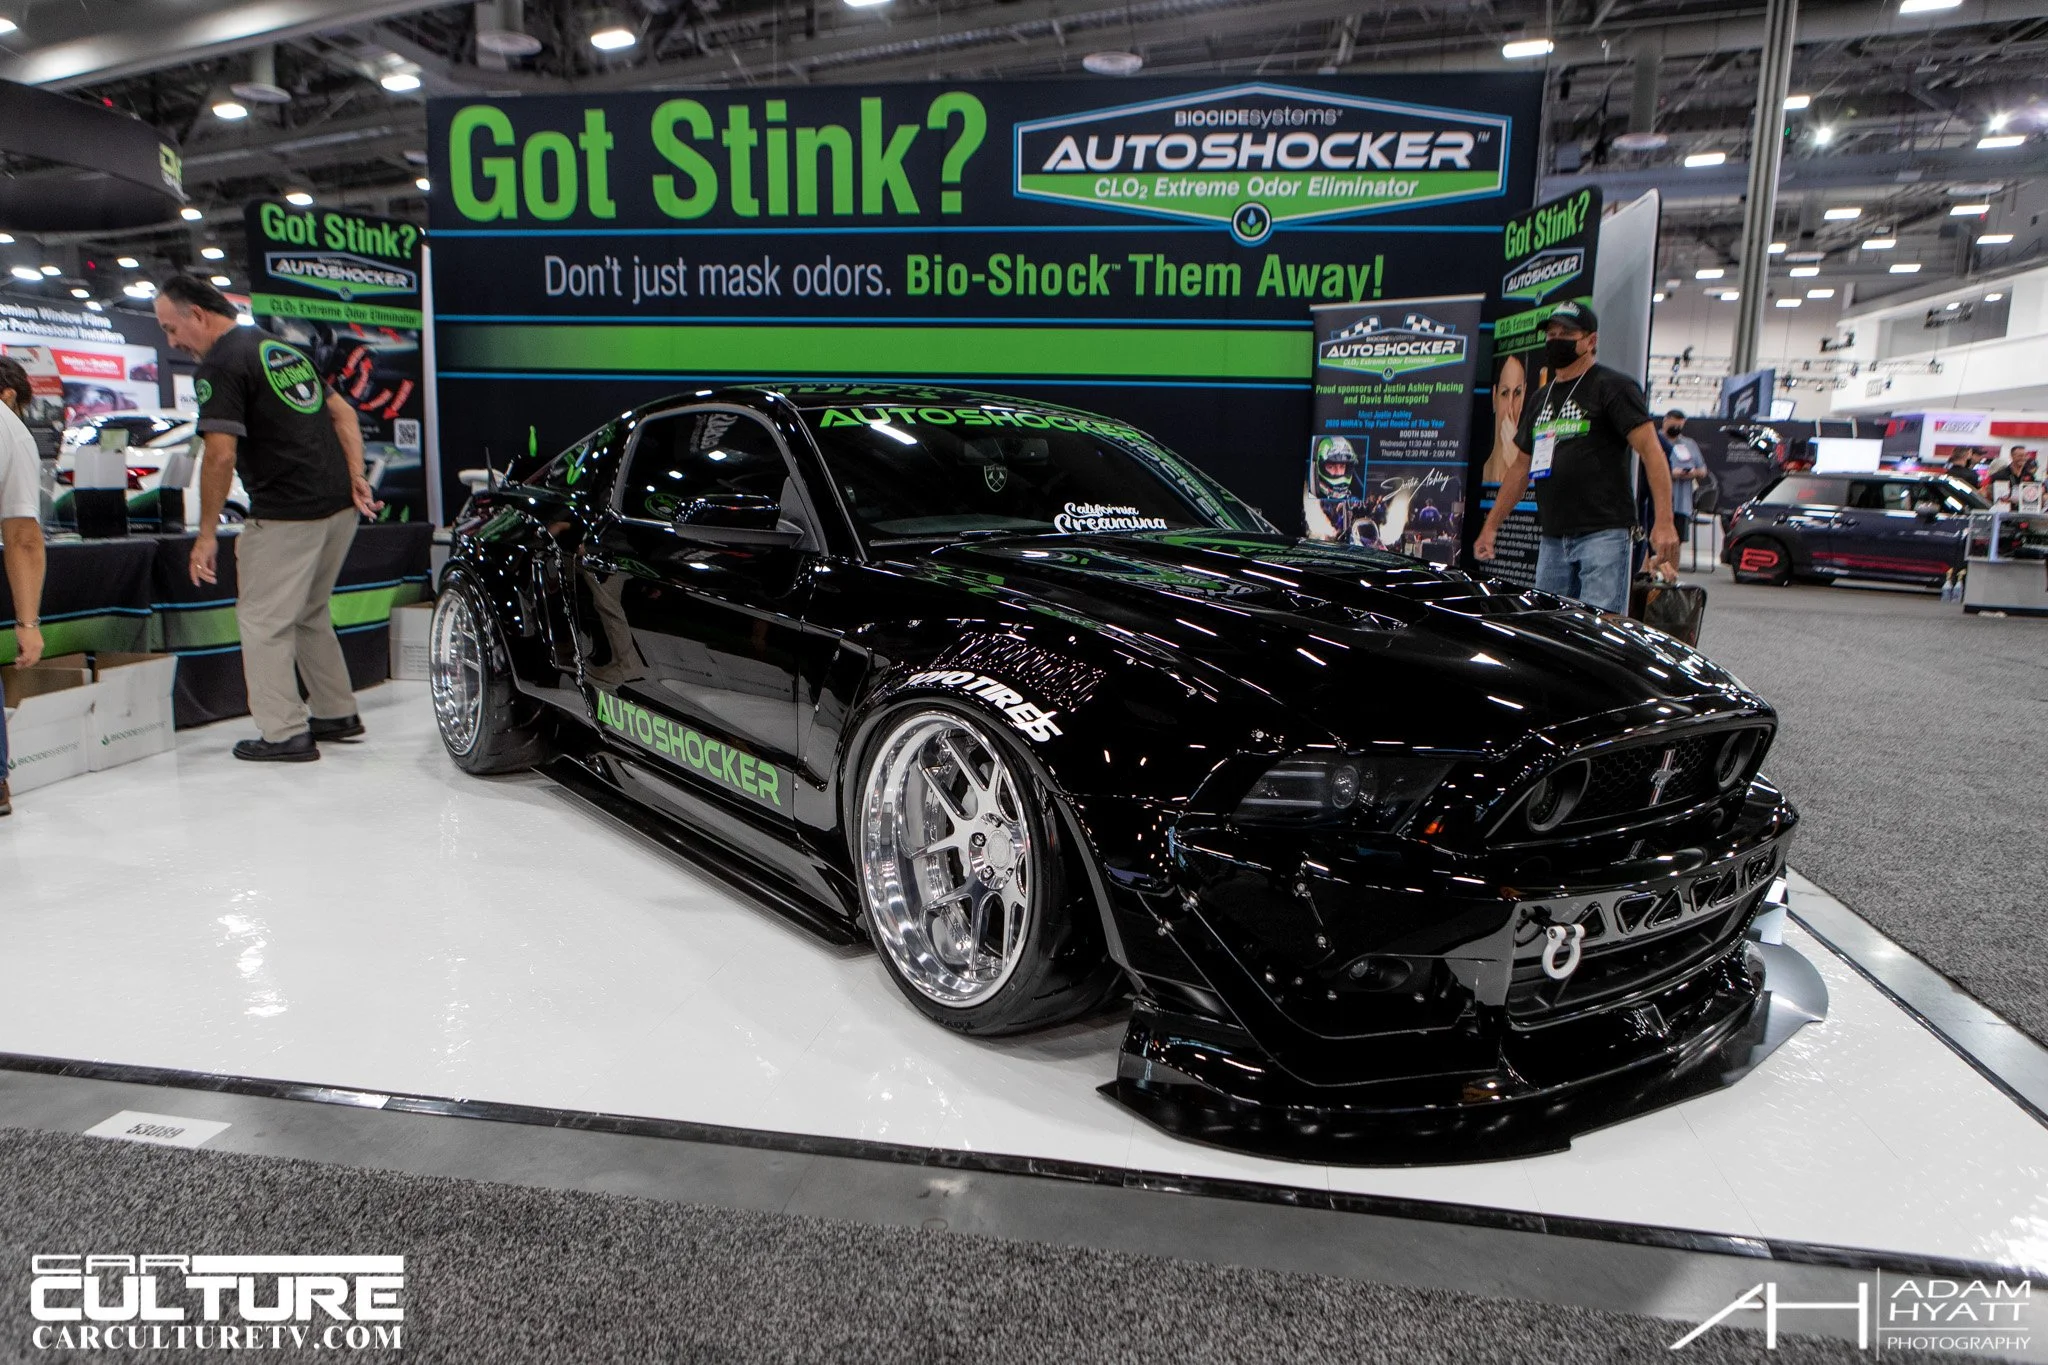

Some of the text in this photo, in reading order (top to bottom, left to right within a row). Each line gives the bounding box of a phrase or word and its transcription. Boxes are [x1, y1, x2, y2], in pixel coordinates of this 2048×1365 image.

[449, 91, 988, 223] Got Stink?
[1153, 176, 1241, 198] Extreme
[1246, 175, 1302, 198] Odor
[1306, 175, 1421, 198] Eliminator
[259, 202, 418, 260] Got Stink?
[1504, 189, 1591, 261] Got Stink?
[275, 258, 409, 289] AUTOSHOCKER
[544, 255, 623, 297] Don't
[631, 255, 688, 305] just
[698, 255, 782, 297] mask
[792, 254, 892, 297] odors.
[1127, 253, 1242, 297] Them
[1256, 254, 1386, 303] Away!
[1506, 255, 1579, 292] AUTOSHOCKER
[1326, 340, 1457, 358] AUTOSHOCKER
[1315, 381, 1464, 396] Proud sponsors of Justin Ashley Racing
[1344, 394, 1429, 406] and Davis Motorsports
[819, 407, 1147, 442] AUTOSHOCKER
[1379, 440, 1408, 448] Wednesday
[1381, 449, 1404, 458] Thursday
[1445, 450, 1456, 458] PM
[1063, 502, 1139, 519] California
[962, 674, 1064, 743] TIRES
[597, 690, 781, 806] AUTOSHOCKER
